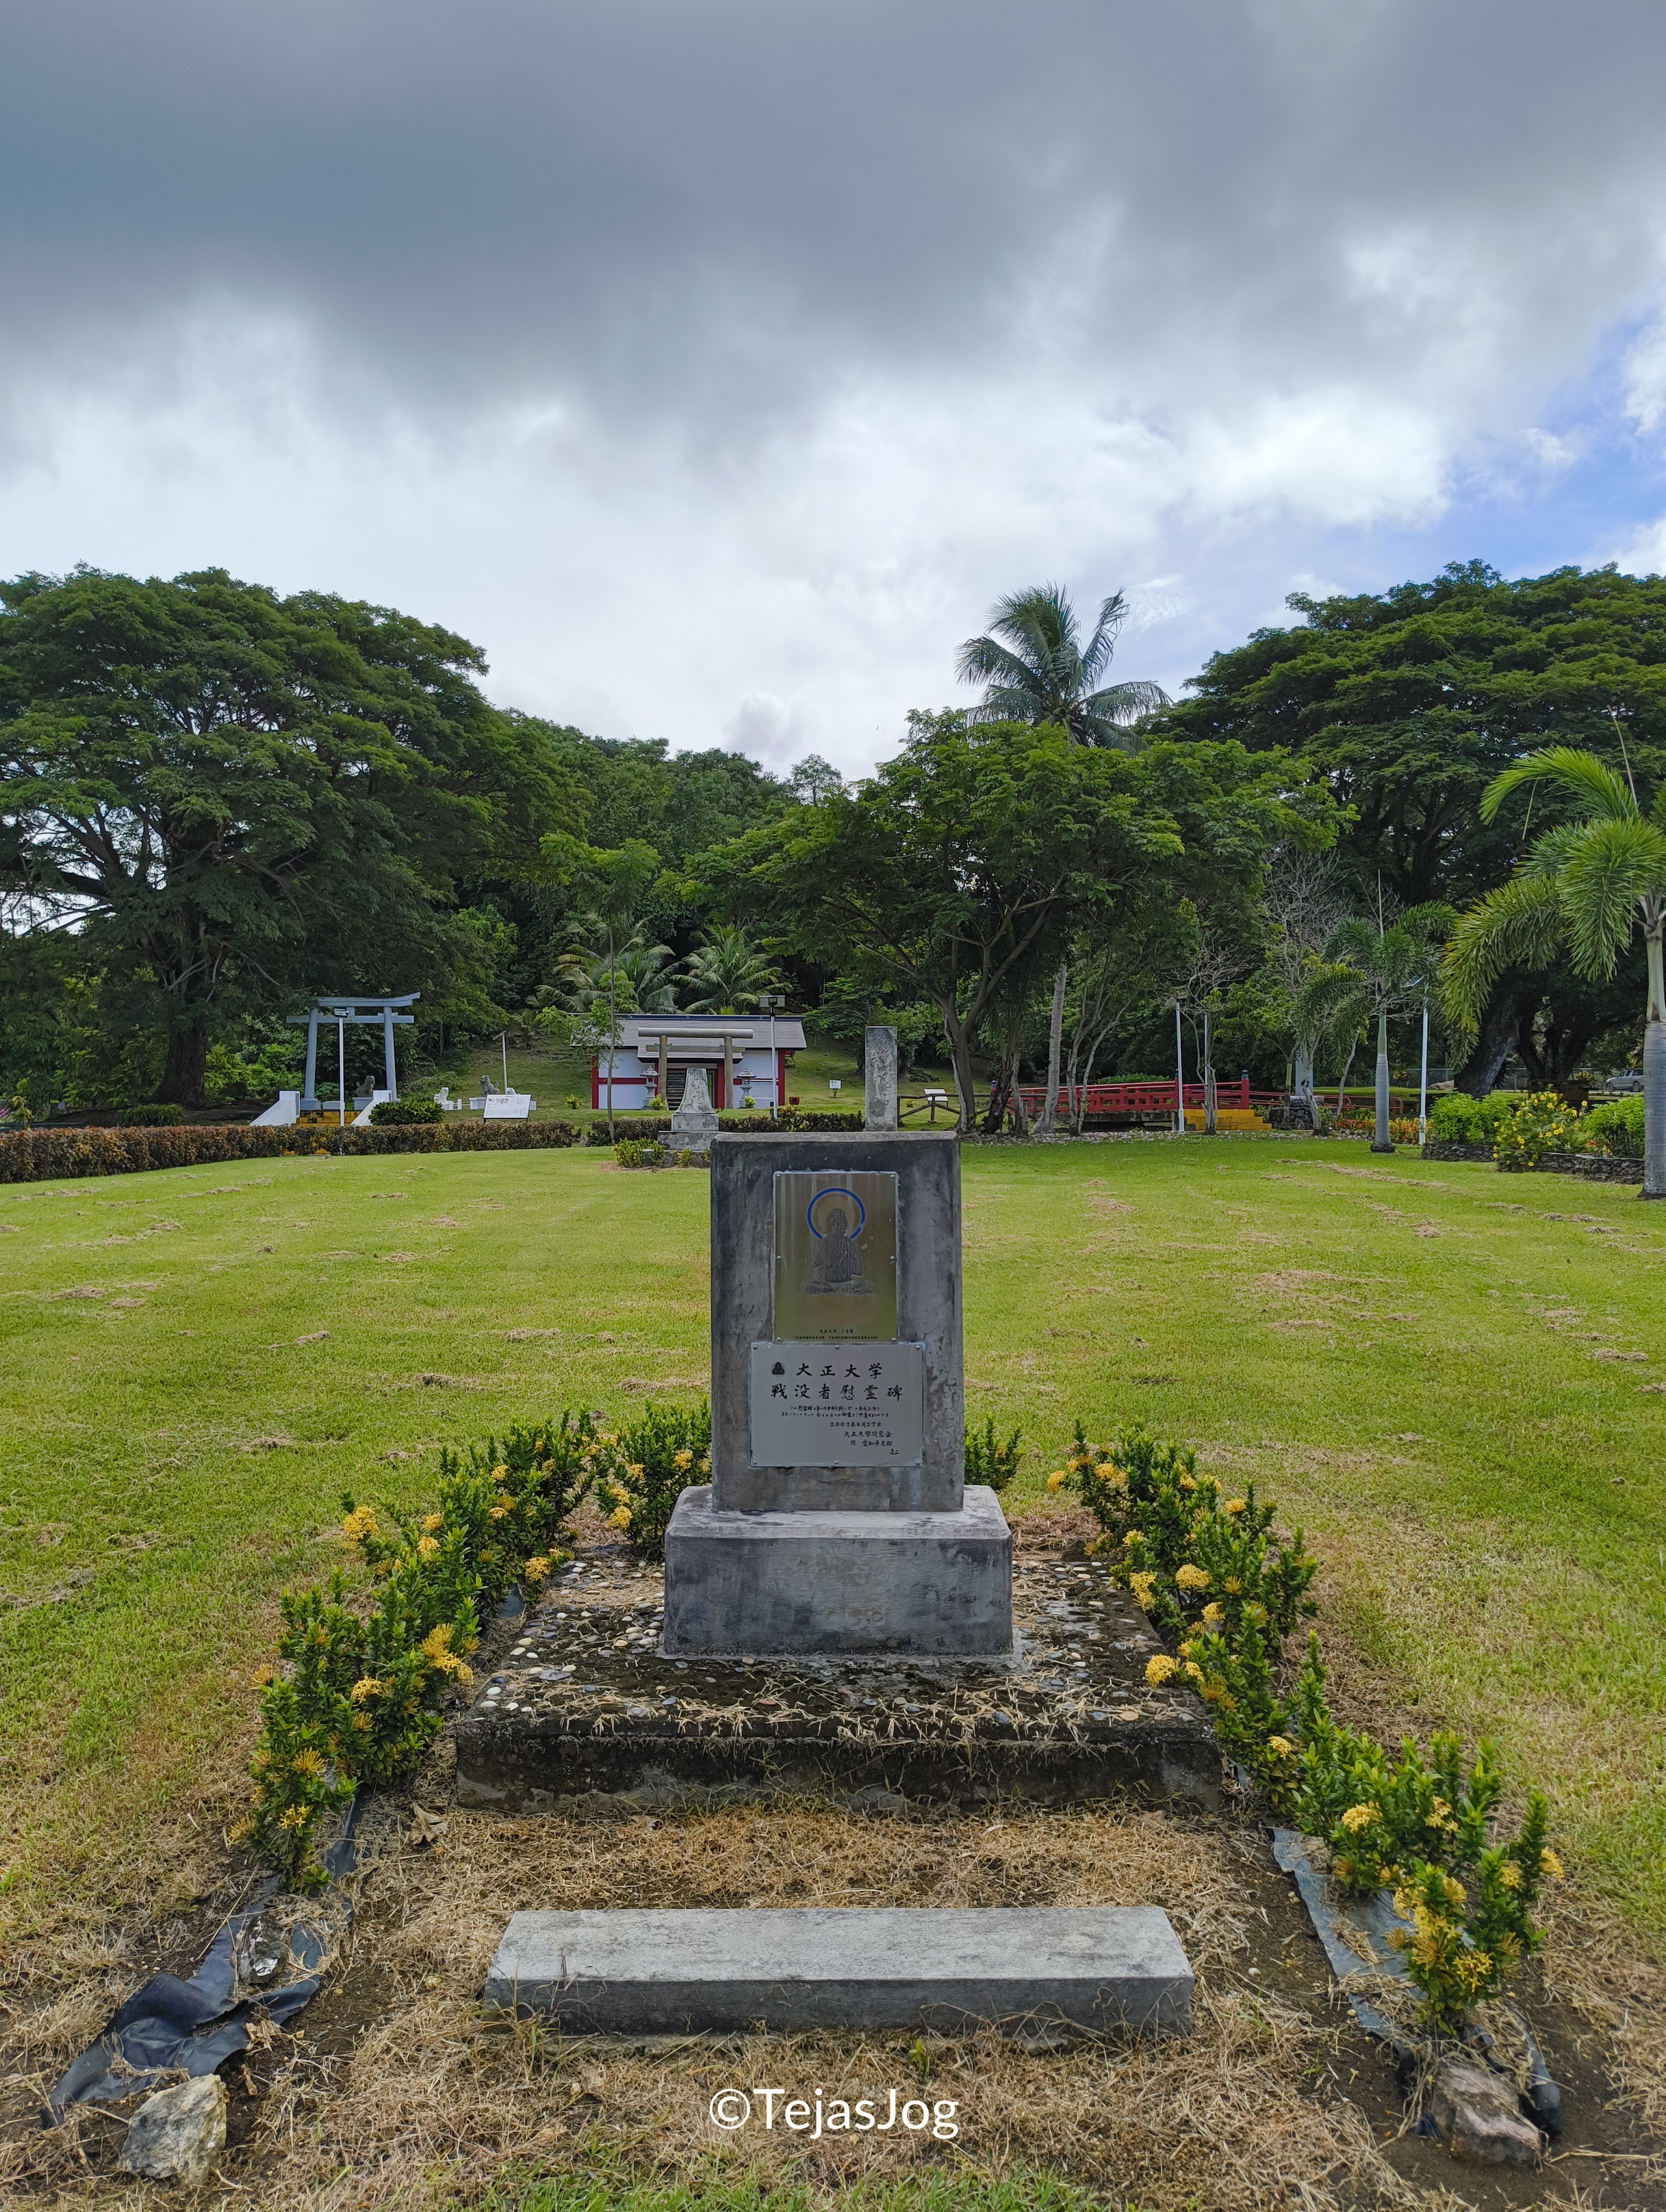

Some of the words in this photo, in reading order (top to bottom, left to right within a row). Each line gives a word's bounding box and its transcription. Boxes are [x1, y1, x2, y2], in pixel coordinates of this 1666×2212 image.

[796, 1362, 882, 1379] 大正大学
[770, 1383, 903, 1401] 戦没者慰霊碑
